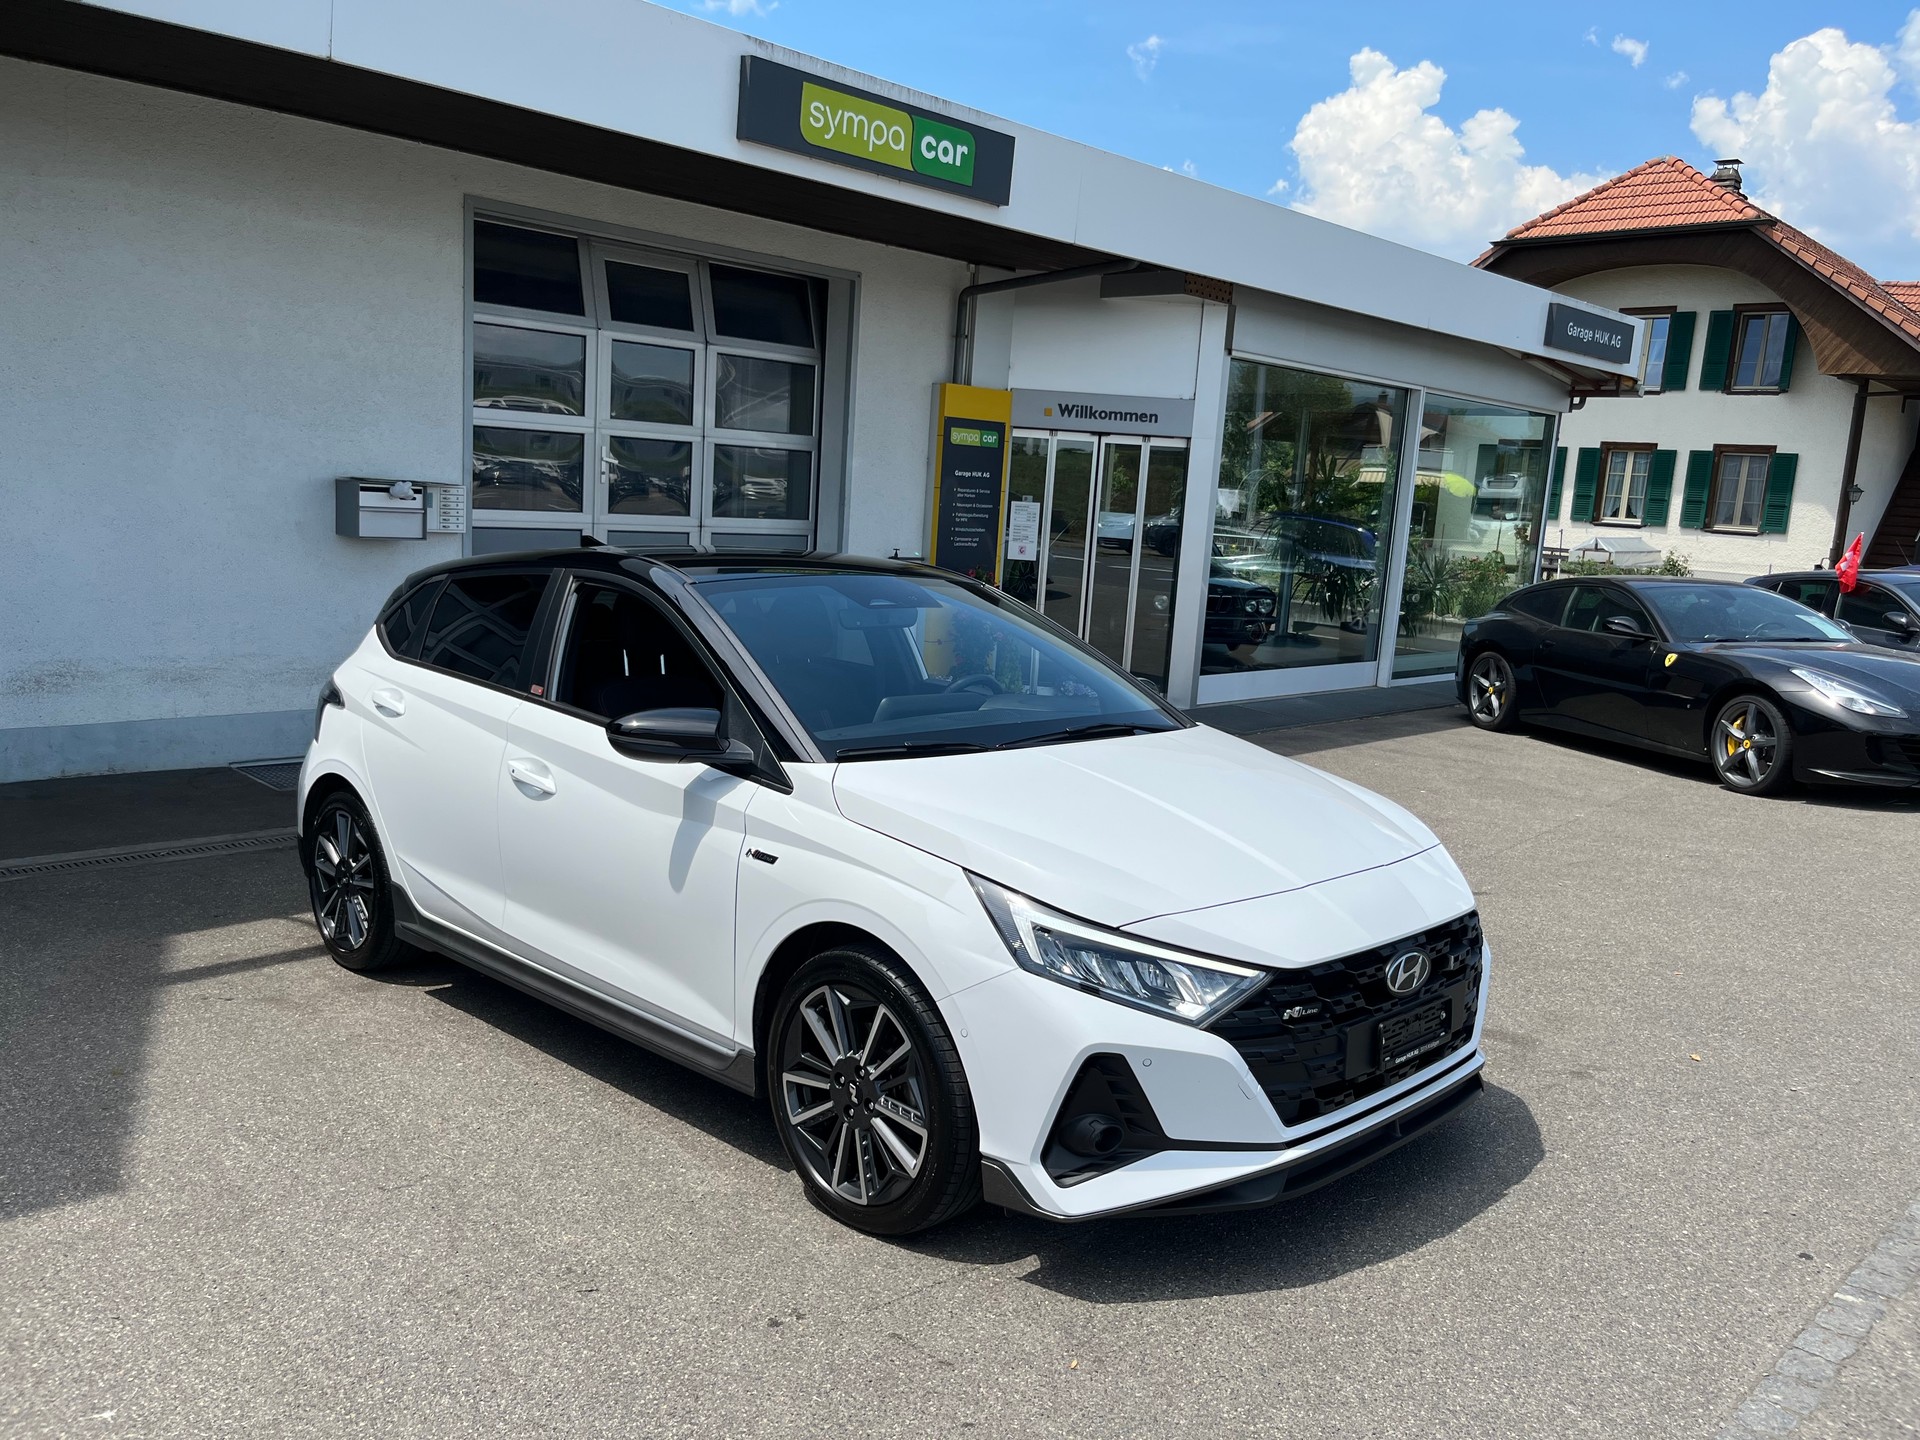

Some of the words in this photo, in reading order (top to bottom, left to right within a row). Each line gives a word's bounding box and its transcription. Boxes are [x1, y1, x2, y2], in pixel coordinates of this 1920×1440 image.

[809, 101, 905, 152] sympa
[920, 135, 968, 167] car
[1567, 322, 1593, 342] Garage
[1594, 329, 1610, 345] HUK
[1610, 334, 1622, 349] AG
[1057, 403, 1159, 424] Willkommen
[952, 431, 979, 443] sympa
[982, 434, 997, 443] car
[954, 469, 971, 478] Garage
